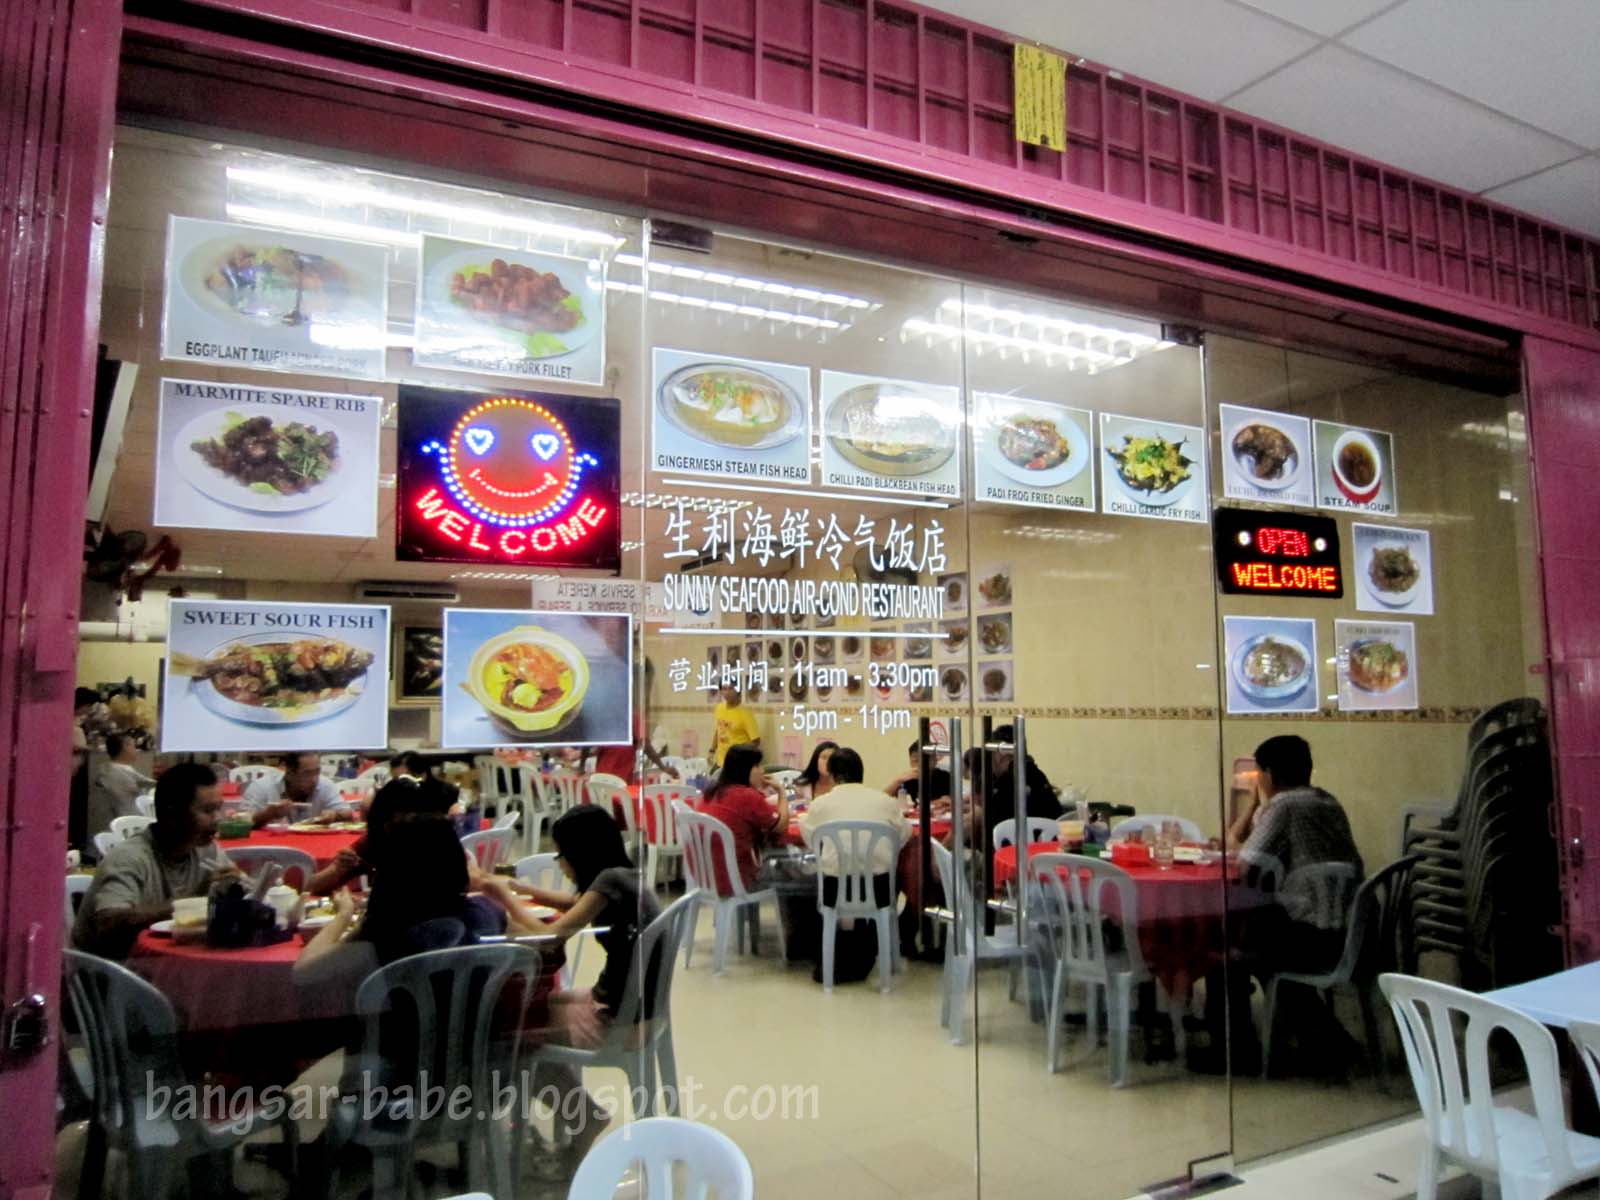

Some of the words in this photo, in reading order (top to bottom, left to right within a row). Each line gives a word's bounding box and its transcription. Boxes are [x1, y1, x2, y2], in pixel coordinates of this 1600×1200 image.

[185, 341, 249, 361] EGGPLANT
[542, 364, 572, 379] FILLET
[175, 383, 266, 403] MARMITE
[271, 391, 330, 409] SPARE
[335, 398, 365, 412] RIB
[658, 454, 722, 473] GINGERMESH
[725, 460, 757, 475] STEAM
[760, 463, 782, 478] FISH
[783, 465, 807, 480] HEAD
[830, 473, 854, 486] CHILLI
[855, 475, 873, 488] PADI
[875, 477, 918, 492] BLACKBEAN
[919, 481, 936, 494] FISH
[937, 482, 956, 495] HEAD
[987, 487, 1006, 499] PADI
[1007, 489, 1029, 502] FROG
[1031, 492, 1054, 504] FRIED
[1056, 494, 1085, 506] GINGER
[415, 487, 607, 555] WELCOME
[1111, 502, 1137, 514] CHILLI
[1168, 506, 1182, 518] FRY
[1184, 508, 1201, 520] FISH
[663, 501, 947, 575] 生利海鲜冷气饭店
[1257, 527, 1309, 557] OPEN
[1232, 562, 1337, 590] WELCOME
[663, 573, 717, 611] SUNNY
[720, 576, 789, 615] SEAFOOD
[792, 579, 859, 617] AIR-COND
[861, 583, 945, 620] RESTAURANT
[184, 609, 260, 627] SWEET
[264, 612, 322, 628] SOUR
[327, 614, 375, 629] FISH
[669, 657, 769, 693] 营业时间
[794, 662, 848, 688] 11am
[868, 662, 939, 693] 3.30pm
[793, 705, 837, 737] 5pm
[859, 704, 911, 735] 11pm
